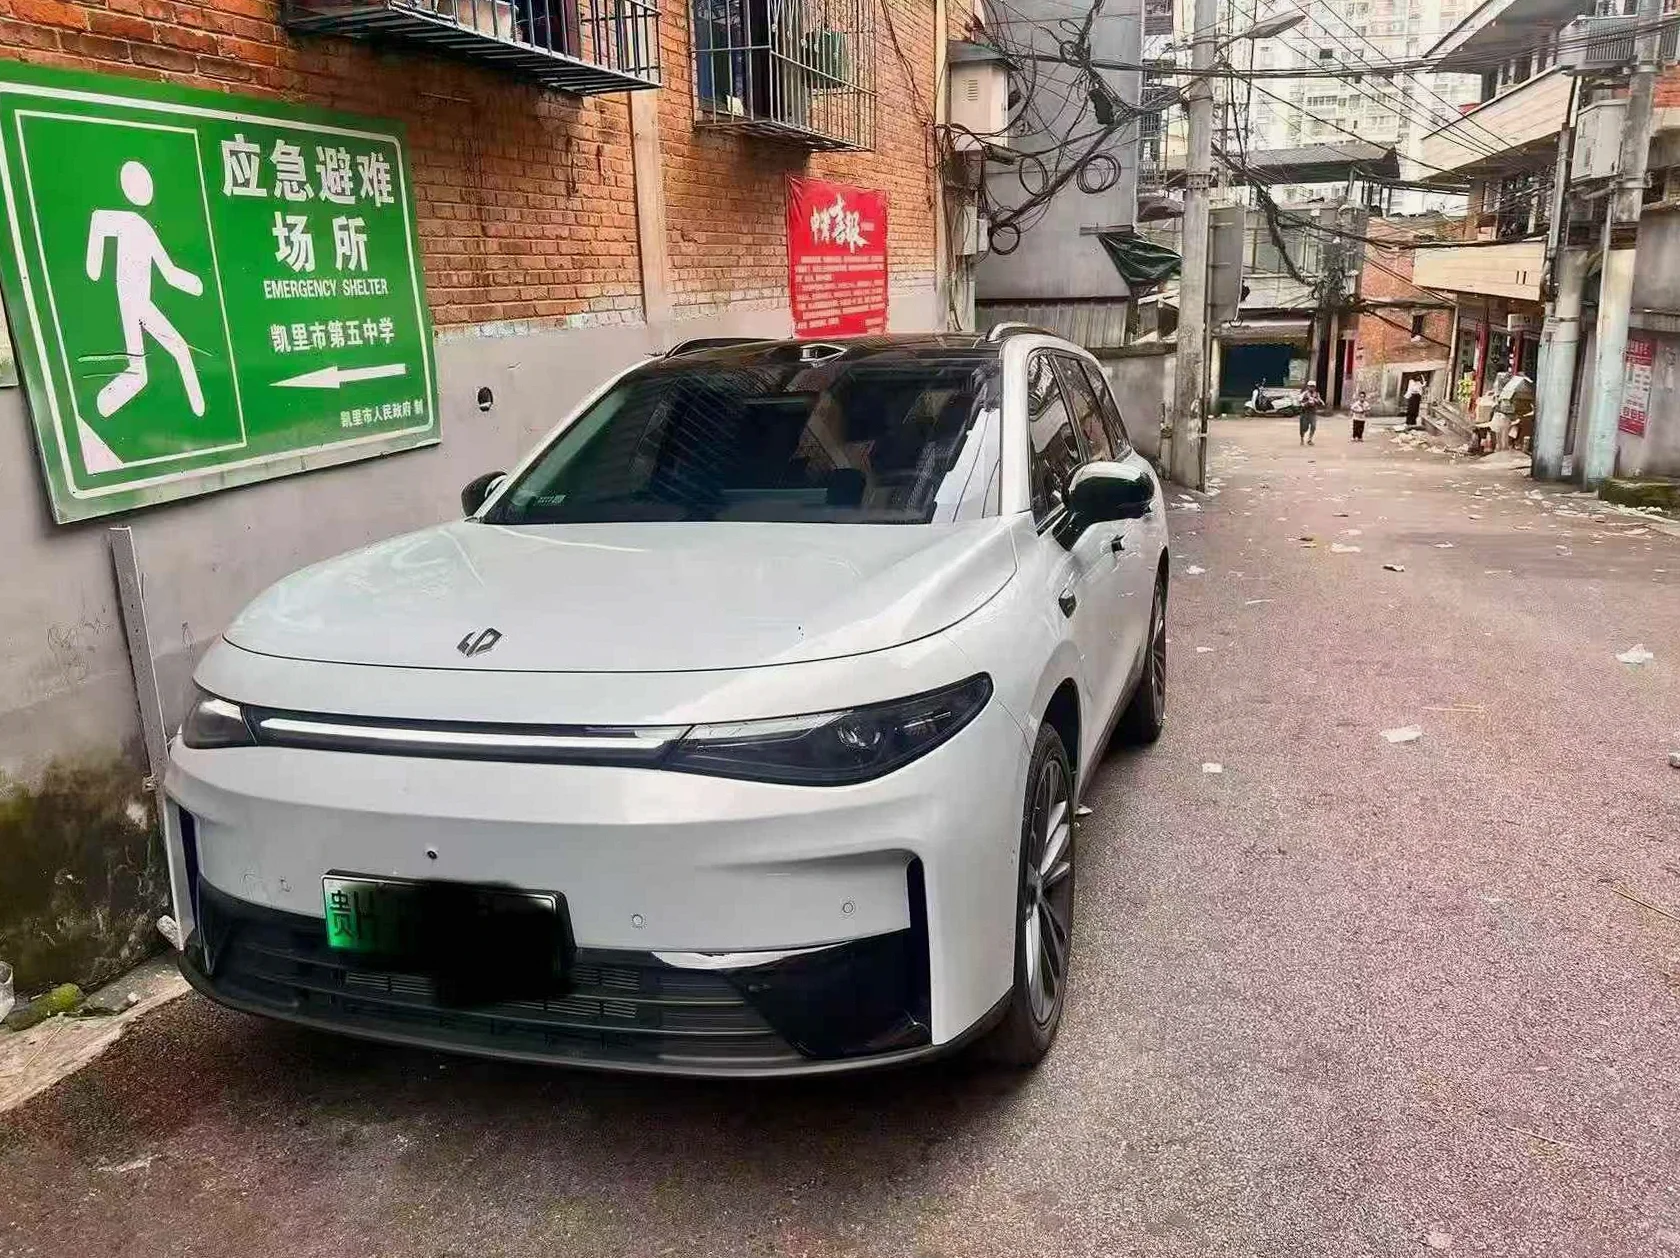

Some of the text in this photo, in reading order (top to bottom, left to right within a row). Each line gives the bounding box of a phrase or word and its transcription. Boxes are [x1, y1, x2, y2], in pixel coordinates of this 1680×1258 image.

[221, 133, 394, 207] 应急避难
[272, 211, 368, 272] 场所
[263, 278, 388, 299] EMERGENCY SHELTER
[270, 317, 395, 352] 凯里市第五中学
